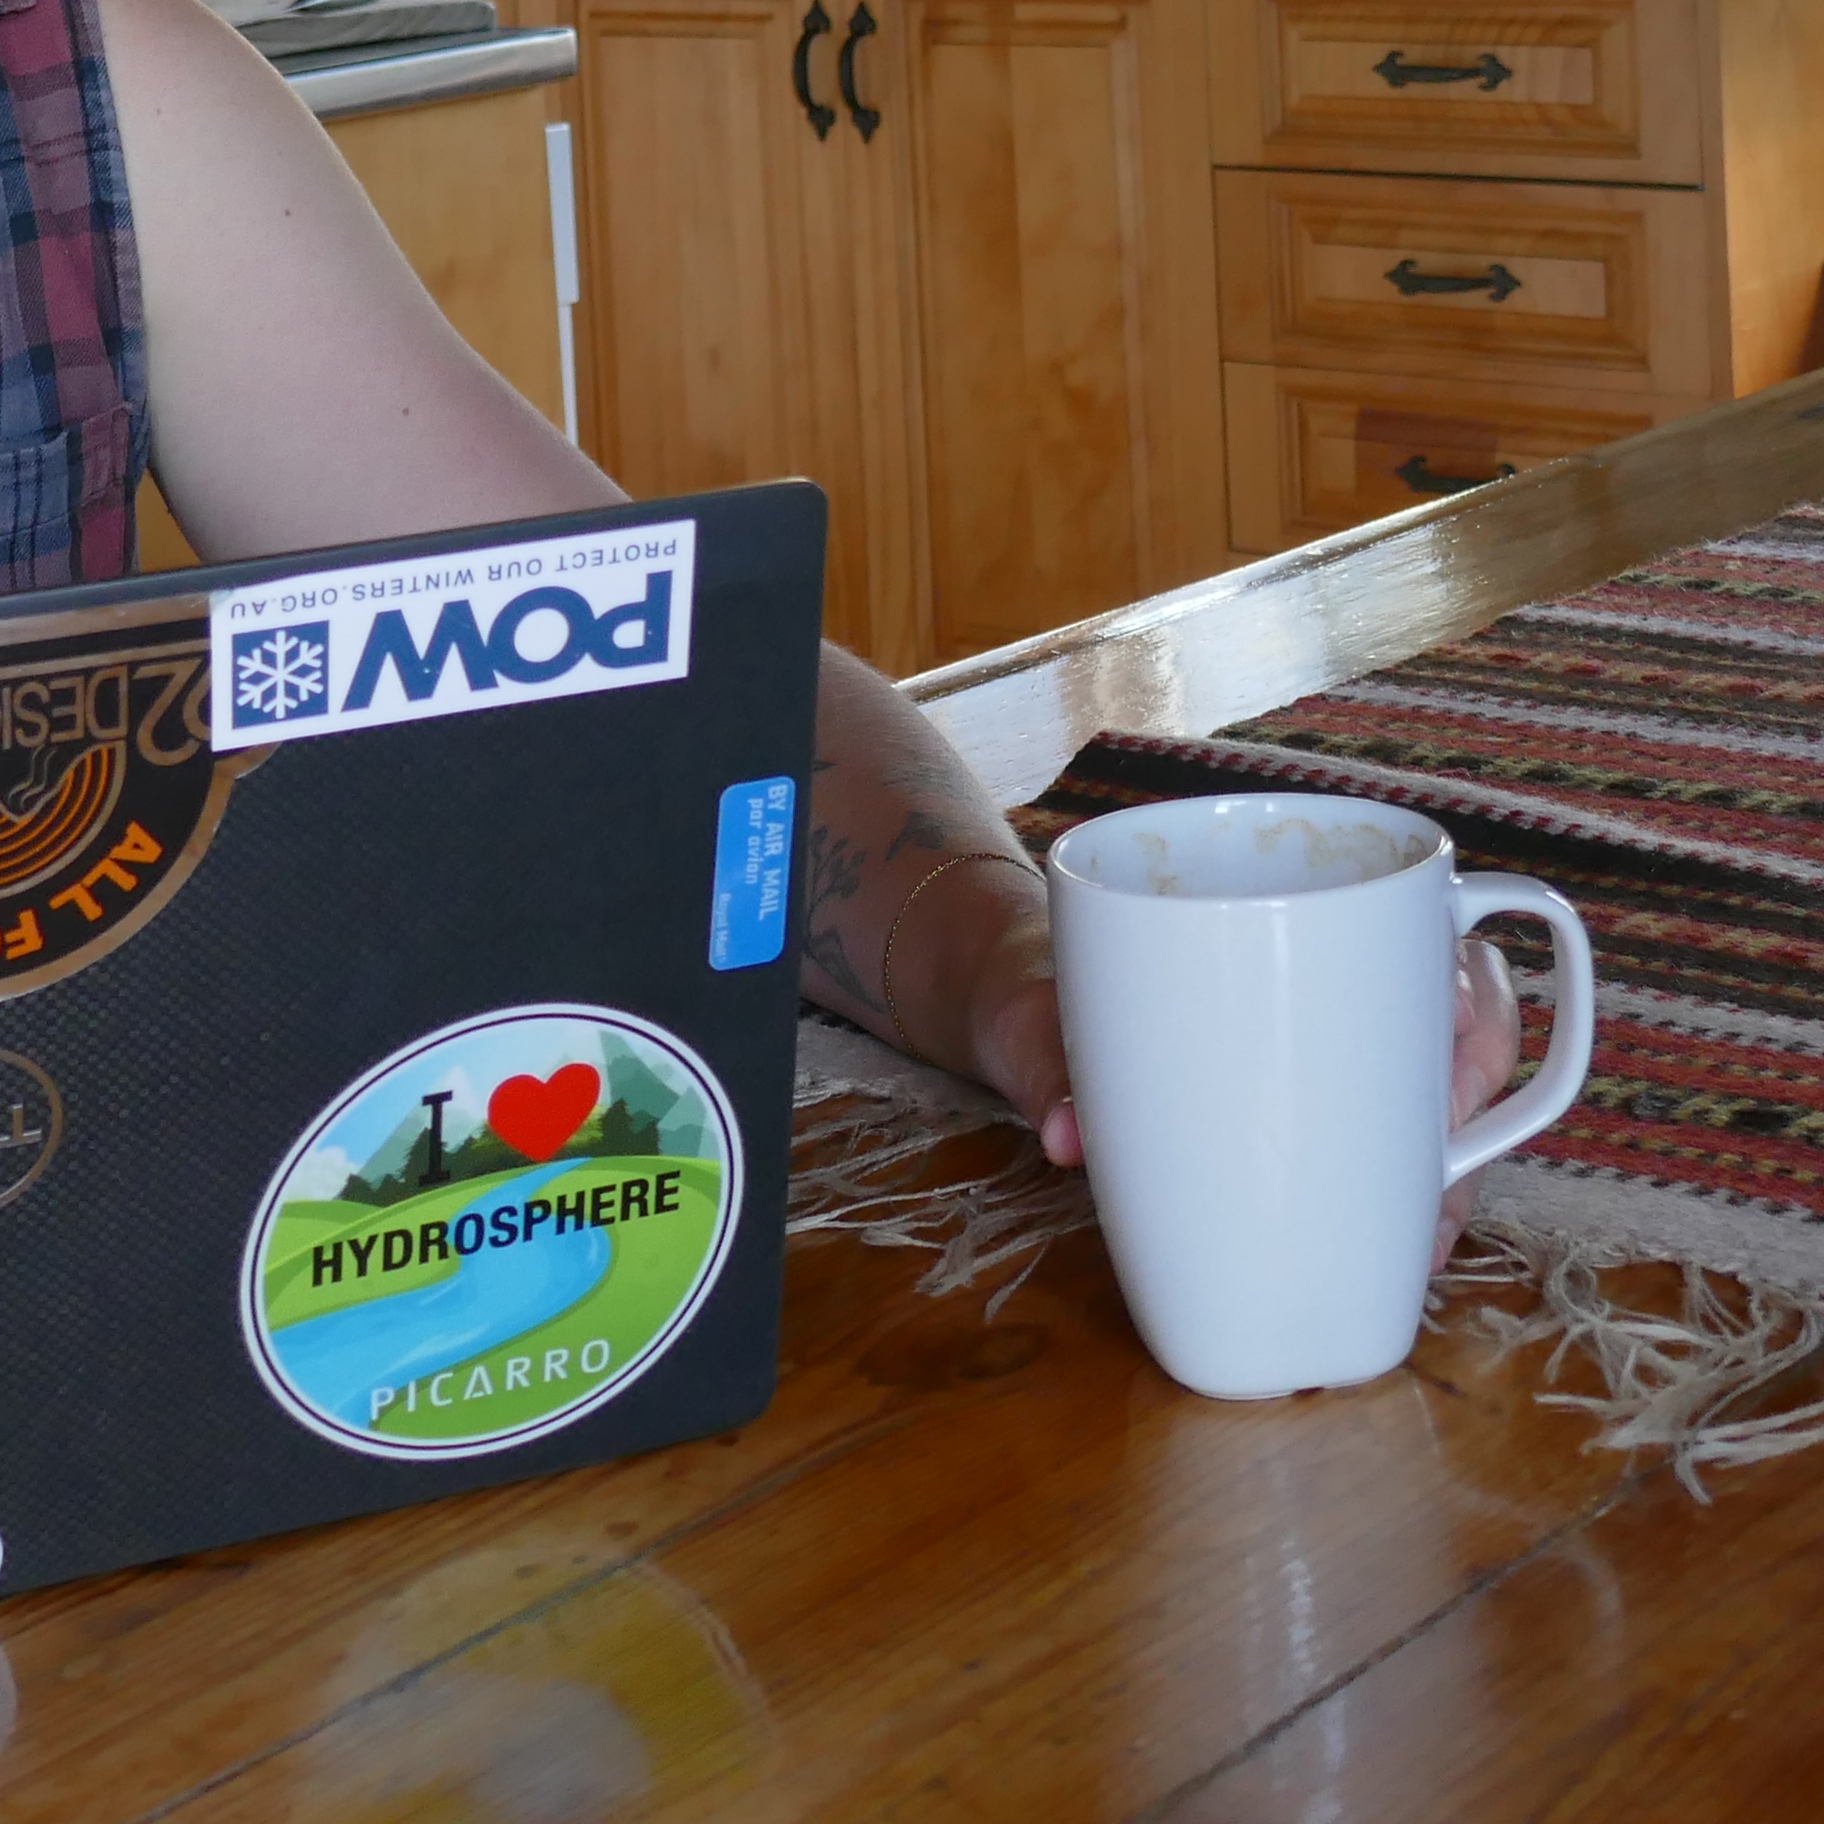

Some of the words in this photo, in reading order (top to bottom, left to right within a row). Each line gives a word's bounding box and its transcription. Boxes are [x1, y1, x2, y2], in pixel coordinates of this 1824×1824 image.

[488, 557, 543, 583] OUR
[555, 538, 677, 572] PROTECT
[230, 567, 475, 619] WINTERS.ORG.AU
[340, 569, 674, 713] POW
[747, 797, 764, 829] par
[768, 784, 788, 811] BY
[745, 836, 764, 885] avion
[765, 822, 784, 857] AIR
[50, 819, 164, 923] ALL
[759, 868, 781, 921] MAIL
[418, 1090, 454, 1188] I
[310, 1170, 682, 1289] HYDROSPHERE
[370, 1338, 612, 1421] PICARRO
